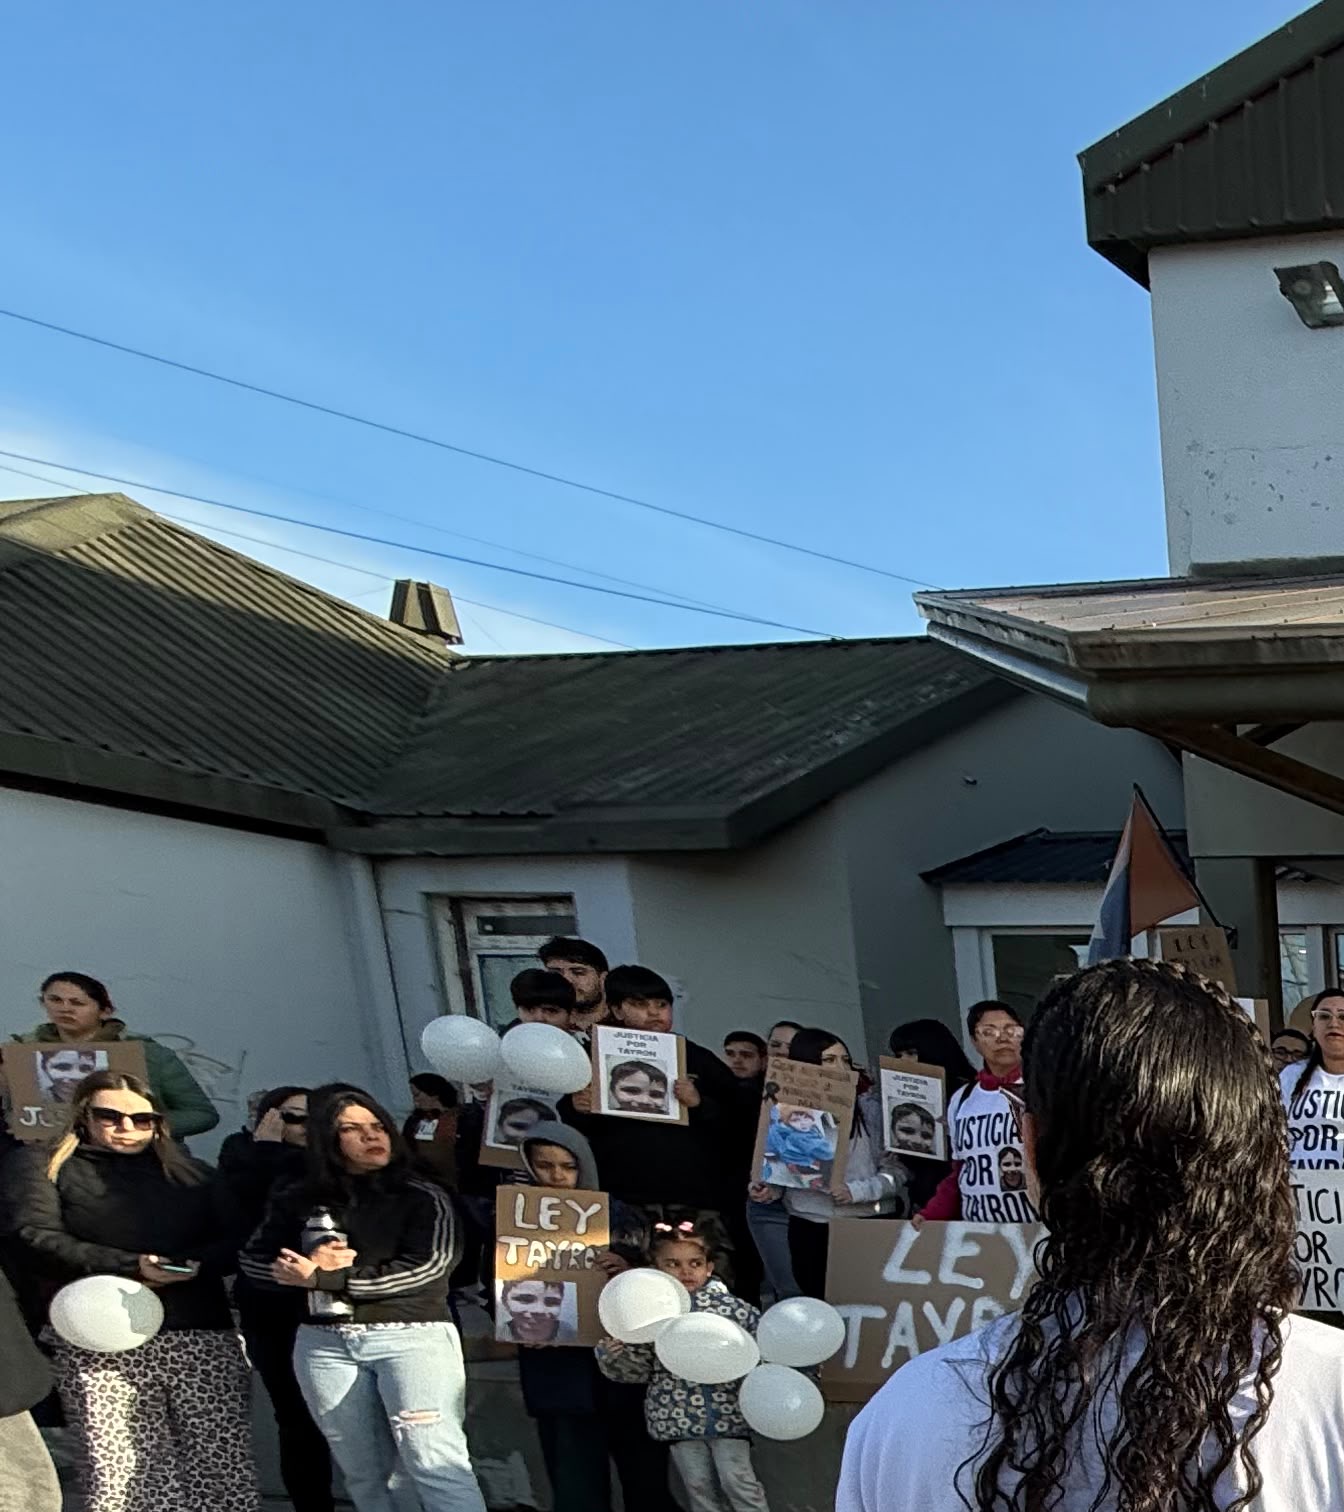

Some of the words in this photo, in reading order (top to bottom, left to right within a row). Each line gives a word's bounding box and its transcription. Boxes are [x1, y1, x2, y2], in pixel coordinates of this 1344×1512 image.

[613, 1031, 659, 1043] JUSTICIA
[617, 1047, 657, 1058] TAYRON
[626, 1040, 647, 1049] POR
[513, 1192, 602, 1235] LEY
[498, 1235, 598, 1270] TAYRO
[882, 1221, 1051, 1300] LEY
[1294, 1231, 1332, 1264] OR
